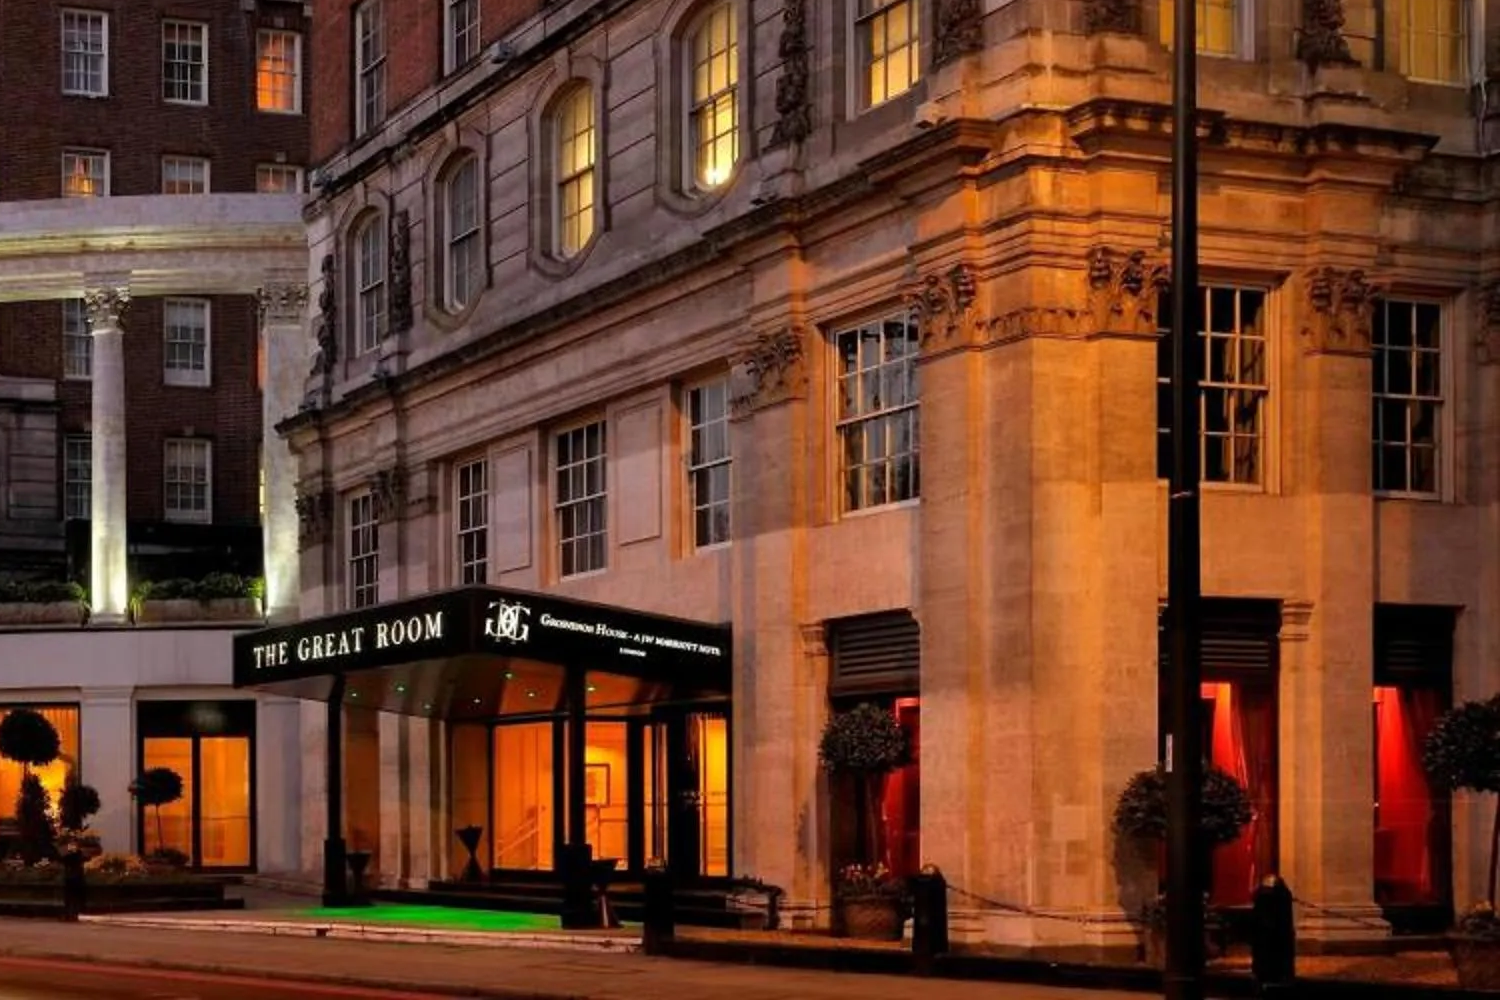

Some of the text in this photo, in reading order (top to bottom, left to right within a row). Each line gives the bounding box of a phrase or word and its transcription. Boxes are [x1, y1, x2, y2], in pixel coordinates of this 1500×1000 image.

[253, 641, 288, 669] THE
[297, 627, 365, 662] GREAT
[376, 611, 444, 649] ROOM
